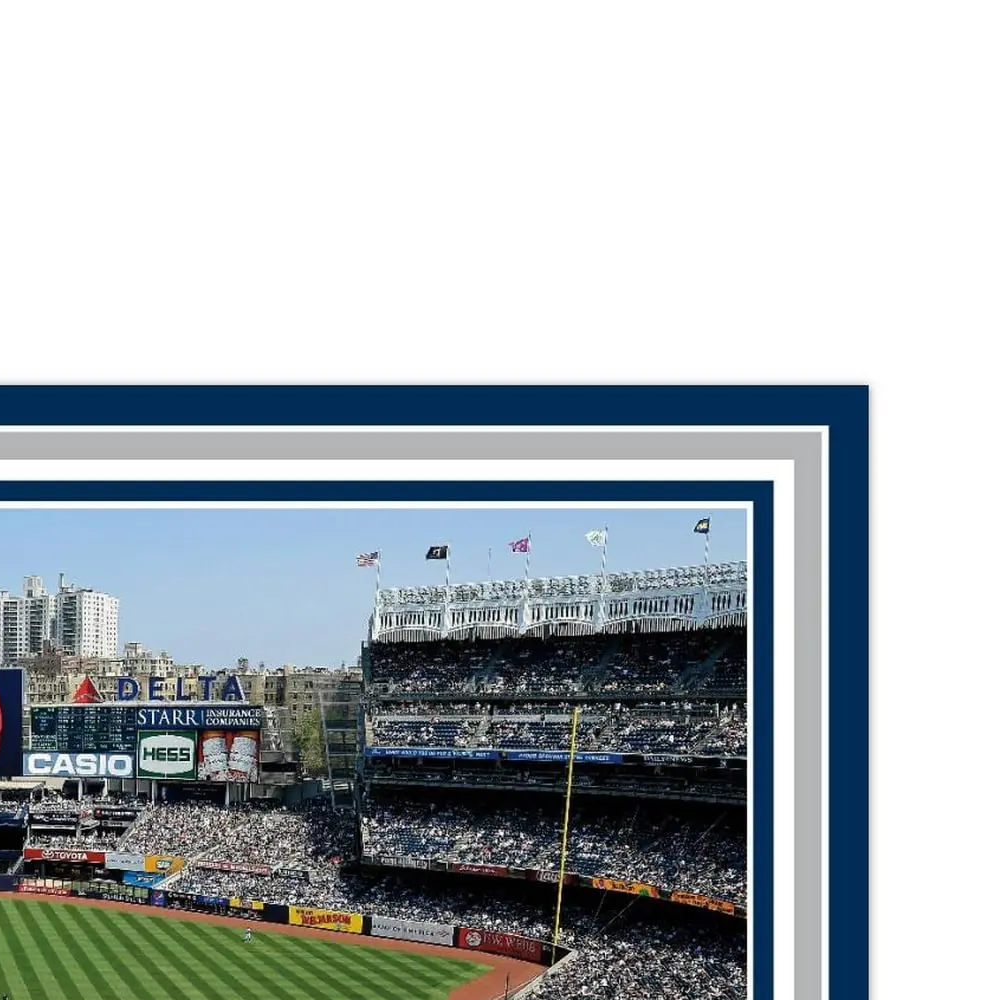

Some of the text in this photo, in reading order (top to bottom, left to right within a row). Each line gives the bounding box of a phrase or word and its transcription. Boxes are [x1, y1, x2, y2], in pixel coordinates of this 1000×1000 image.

[117, 676, 246, 701] DELTA
[137, 709, 199, 726] STARR
[206, 709, 260, 718] INSURANCE
[206, 717, 260, 726] COMPANIES
[143, 747, 191, 761] HESS
[28, 753, 132, 776] CASIO
[54, 852, 88, 861] TOYOTA
